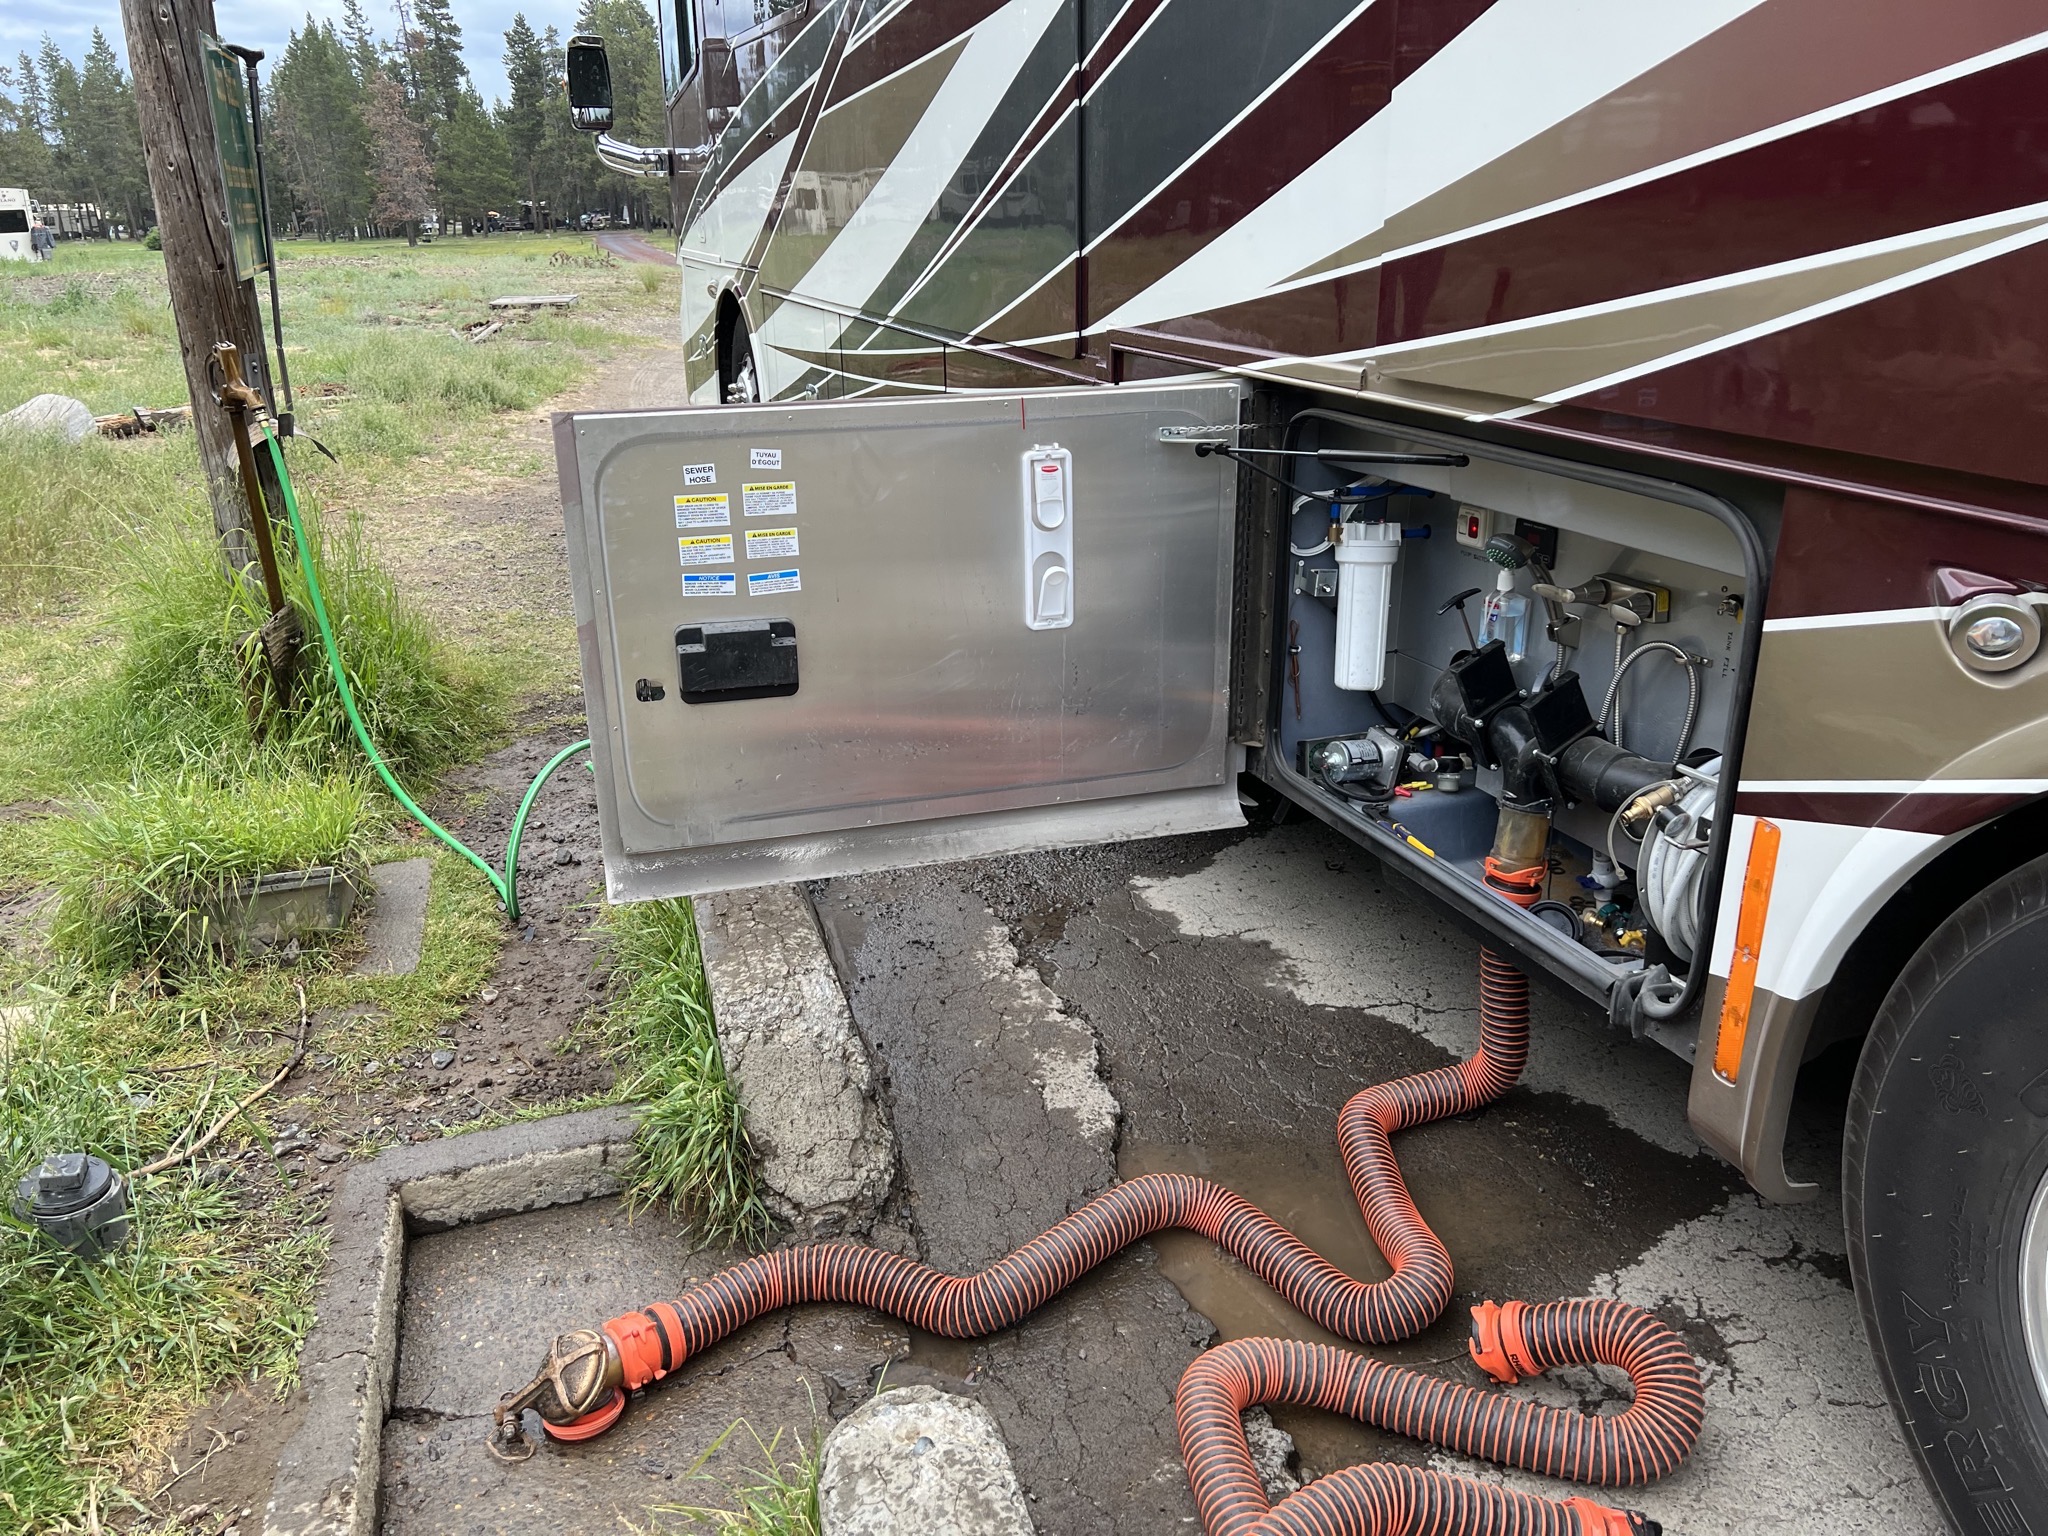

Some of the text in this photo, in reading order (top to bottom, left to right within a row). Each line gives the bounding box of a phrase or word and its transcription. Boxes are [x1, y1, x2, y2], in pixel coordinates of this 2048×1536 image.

[685, 465, 714, 475] SEWER
[689, 475, 712, 484] HOSE
[1721, 631, 1734, 679] TANK FILL
